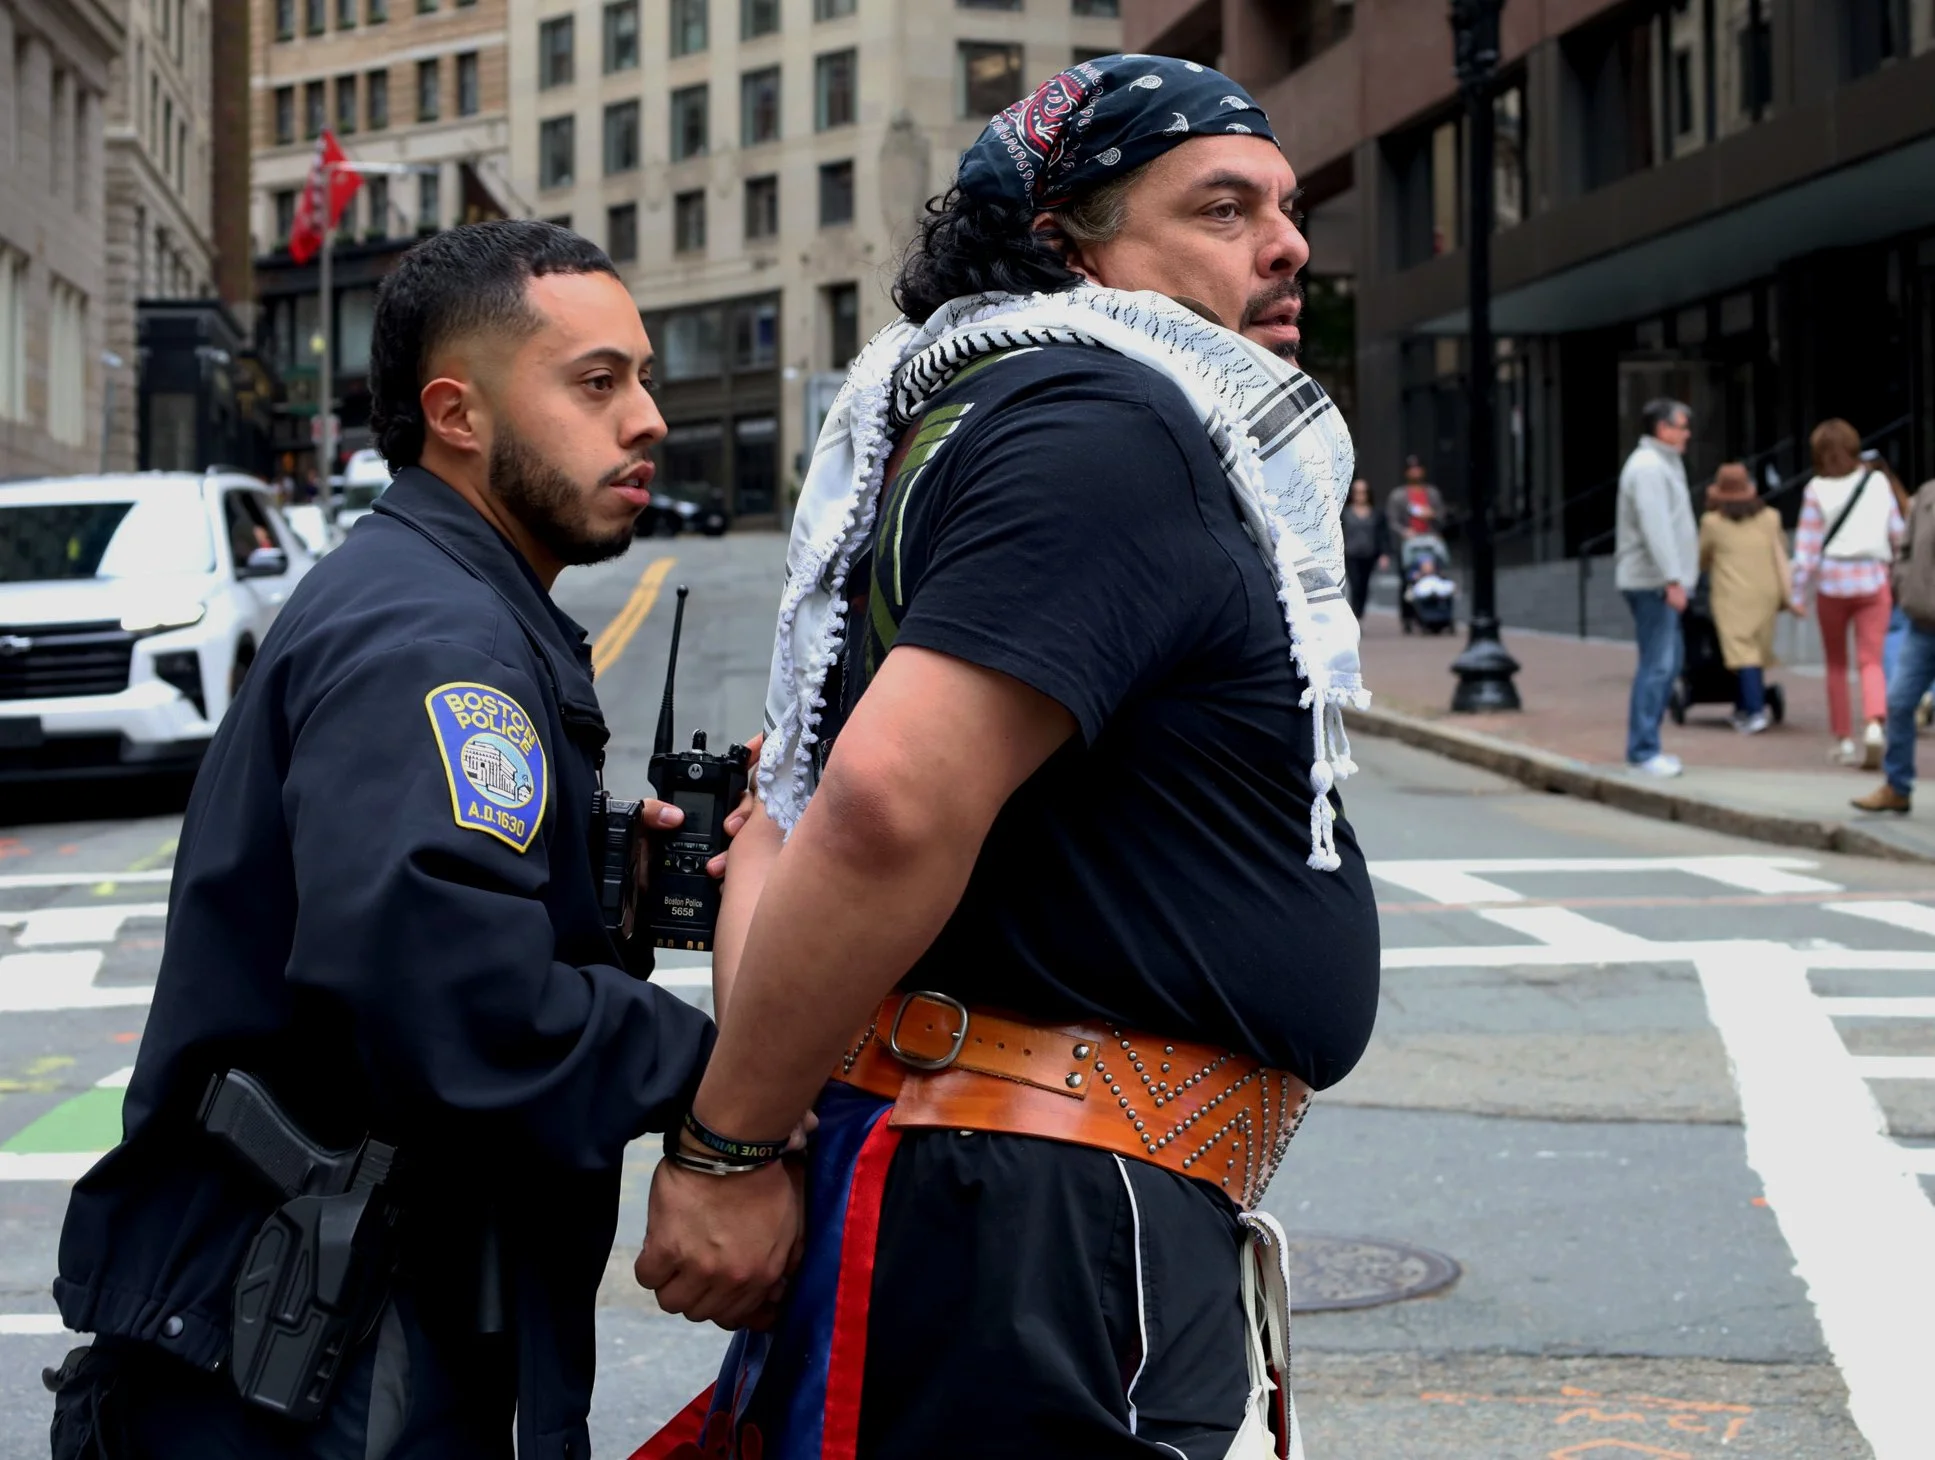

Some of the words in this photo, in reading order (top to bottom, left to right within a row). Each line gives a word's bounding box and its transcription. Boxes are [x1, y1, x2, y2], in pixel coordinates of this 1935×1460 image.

[443, 691, 537, 746] BOSTON
[455, 711, 533, 757] POLICE
[664, 896, 684, 906] Boston
[685, 898, 703, 908] Police
[671, 906, 694, 917] 5658
[703, 1132, 737, 1154] WINS
[740, 1145, 774, 1157] LOVE
